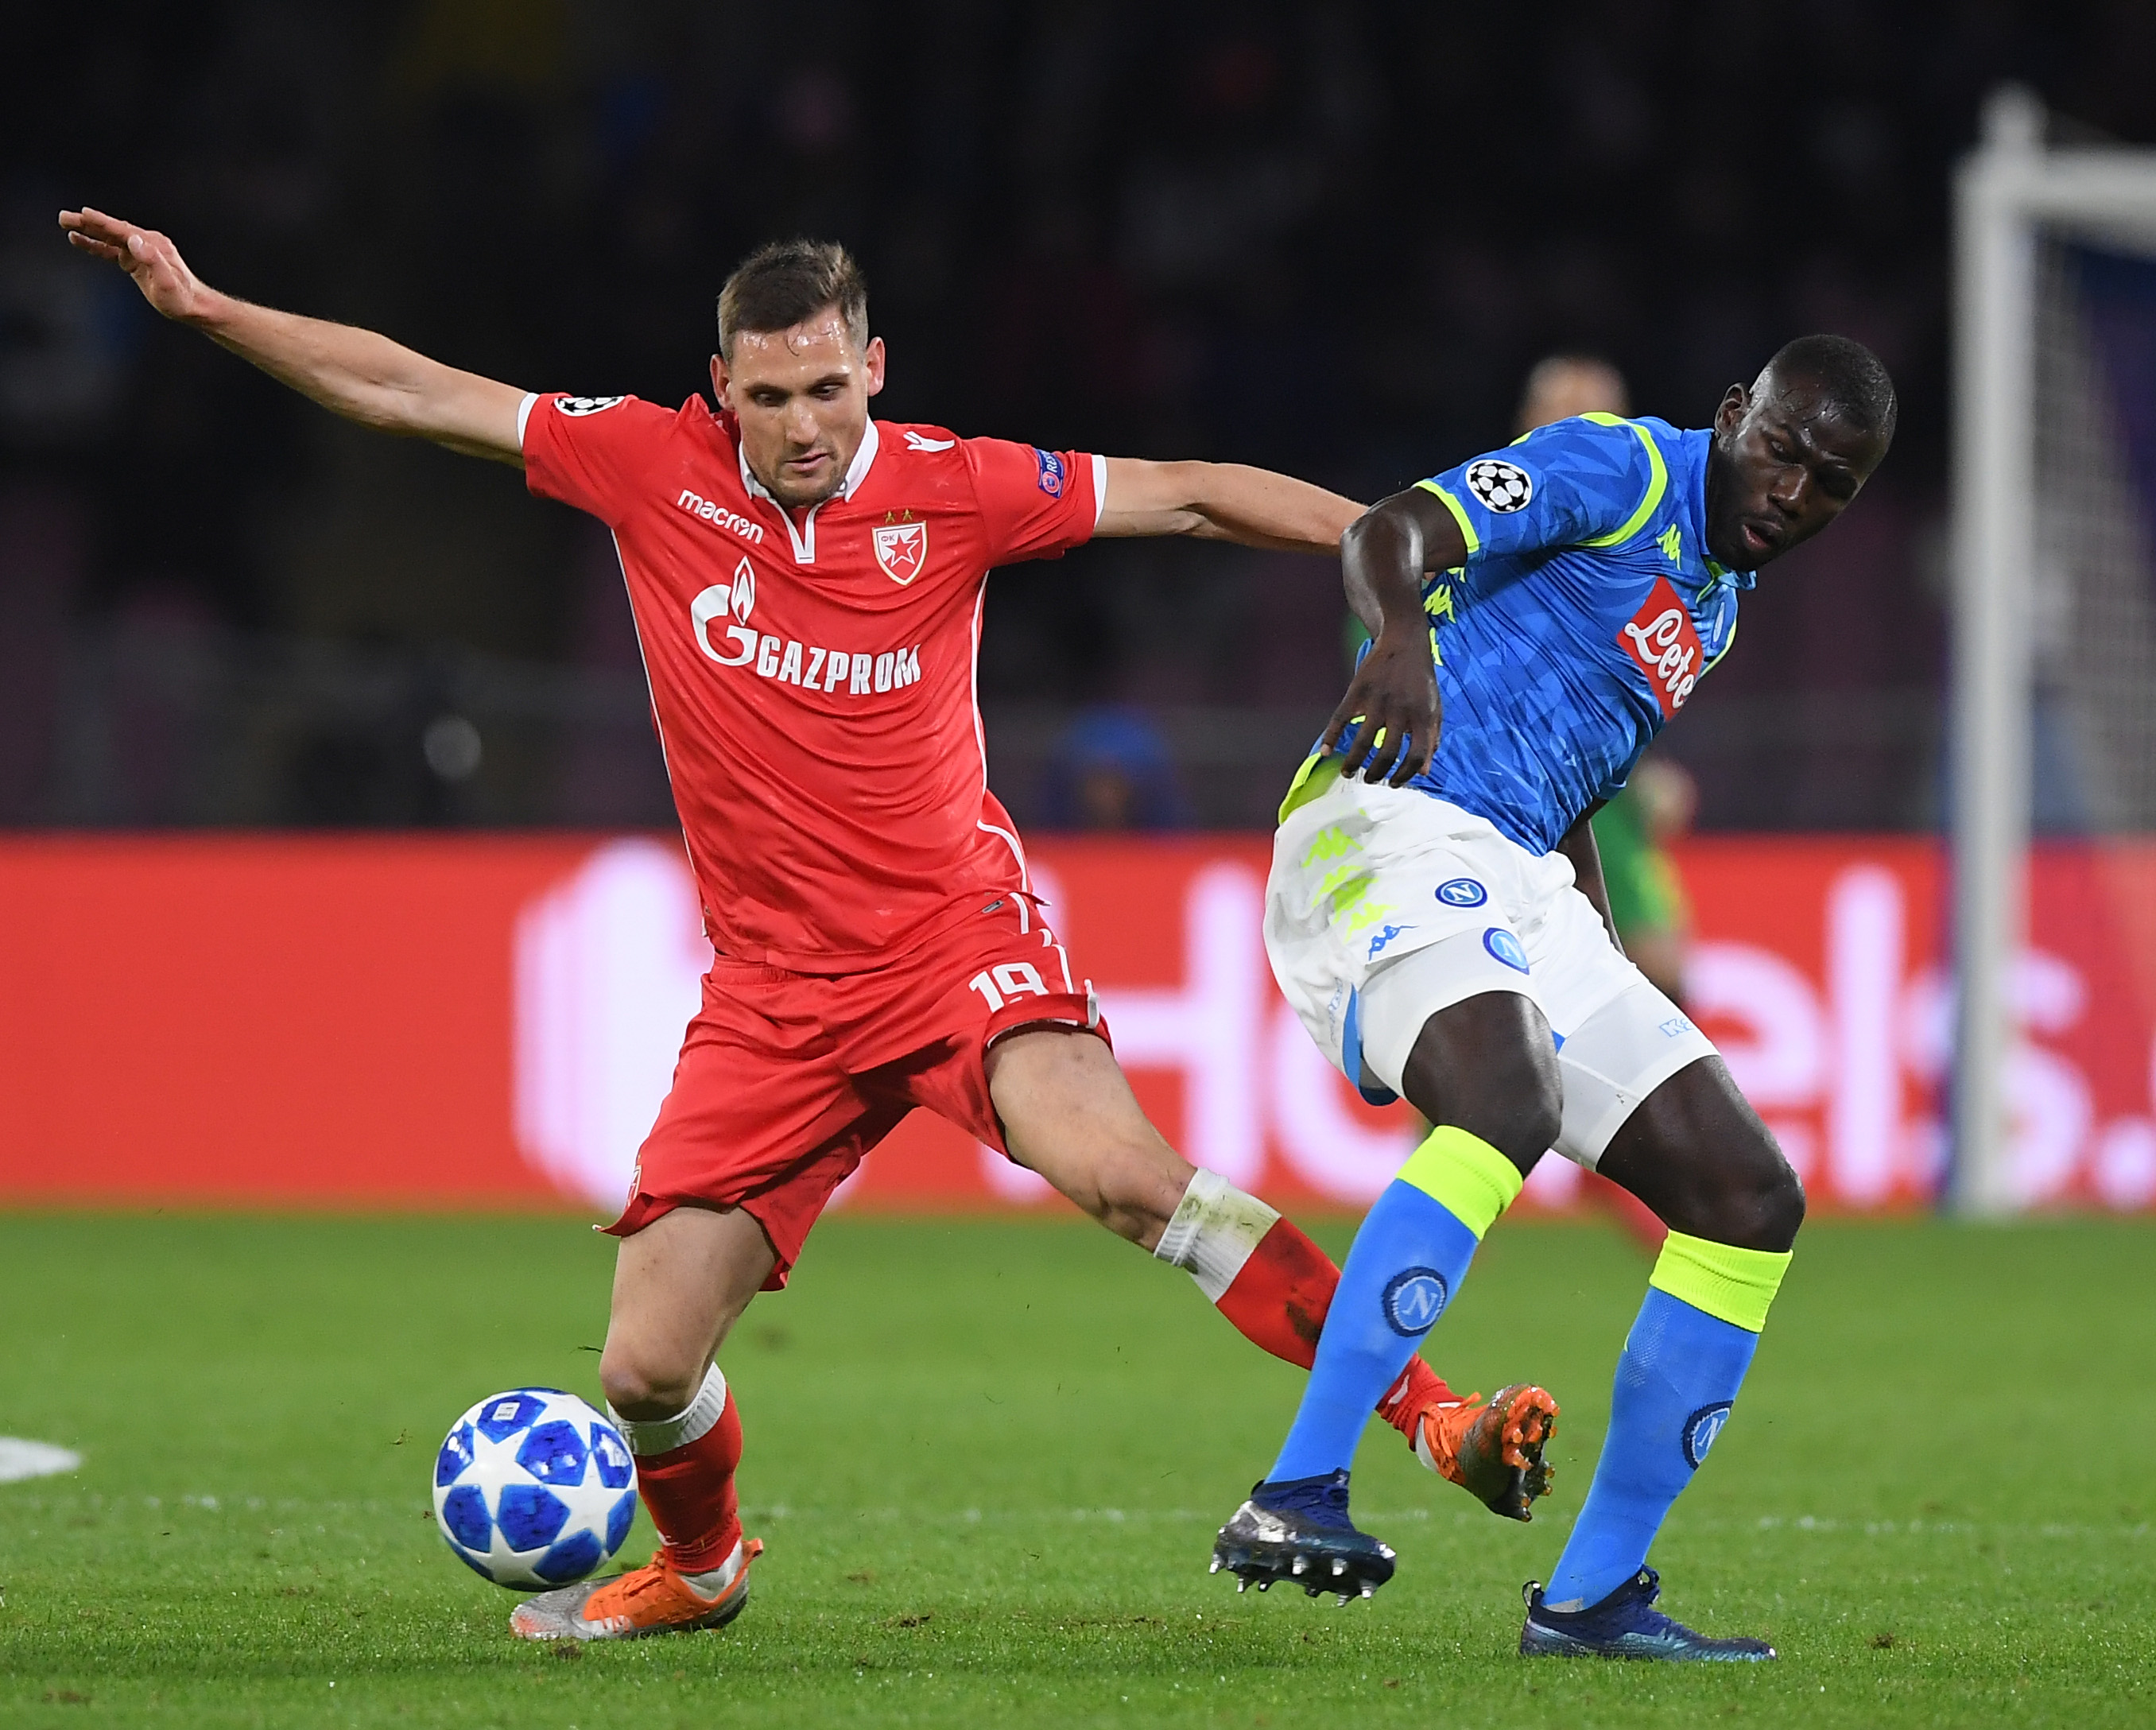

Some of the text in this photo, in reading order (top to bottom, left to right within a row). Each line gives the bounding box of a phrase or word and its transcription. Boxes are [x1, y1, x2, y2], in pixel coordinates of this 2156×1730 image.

[677, 489, 764, 545] macron
[756, 634, 921, 695] GAZPROM
[1624, 608, 1695, 708] Lete
[1446, 883, 1475, 902] N
[968, 962, 1049, 1014] 19
